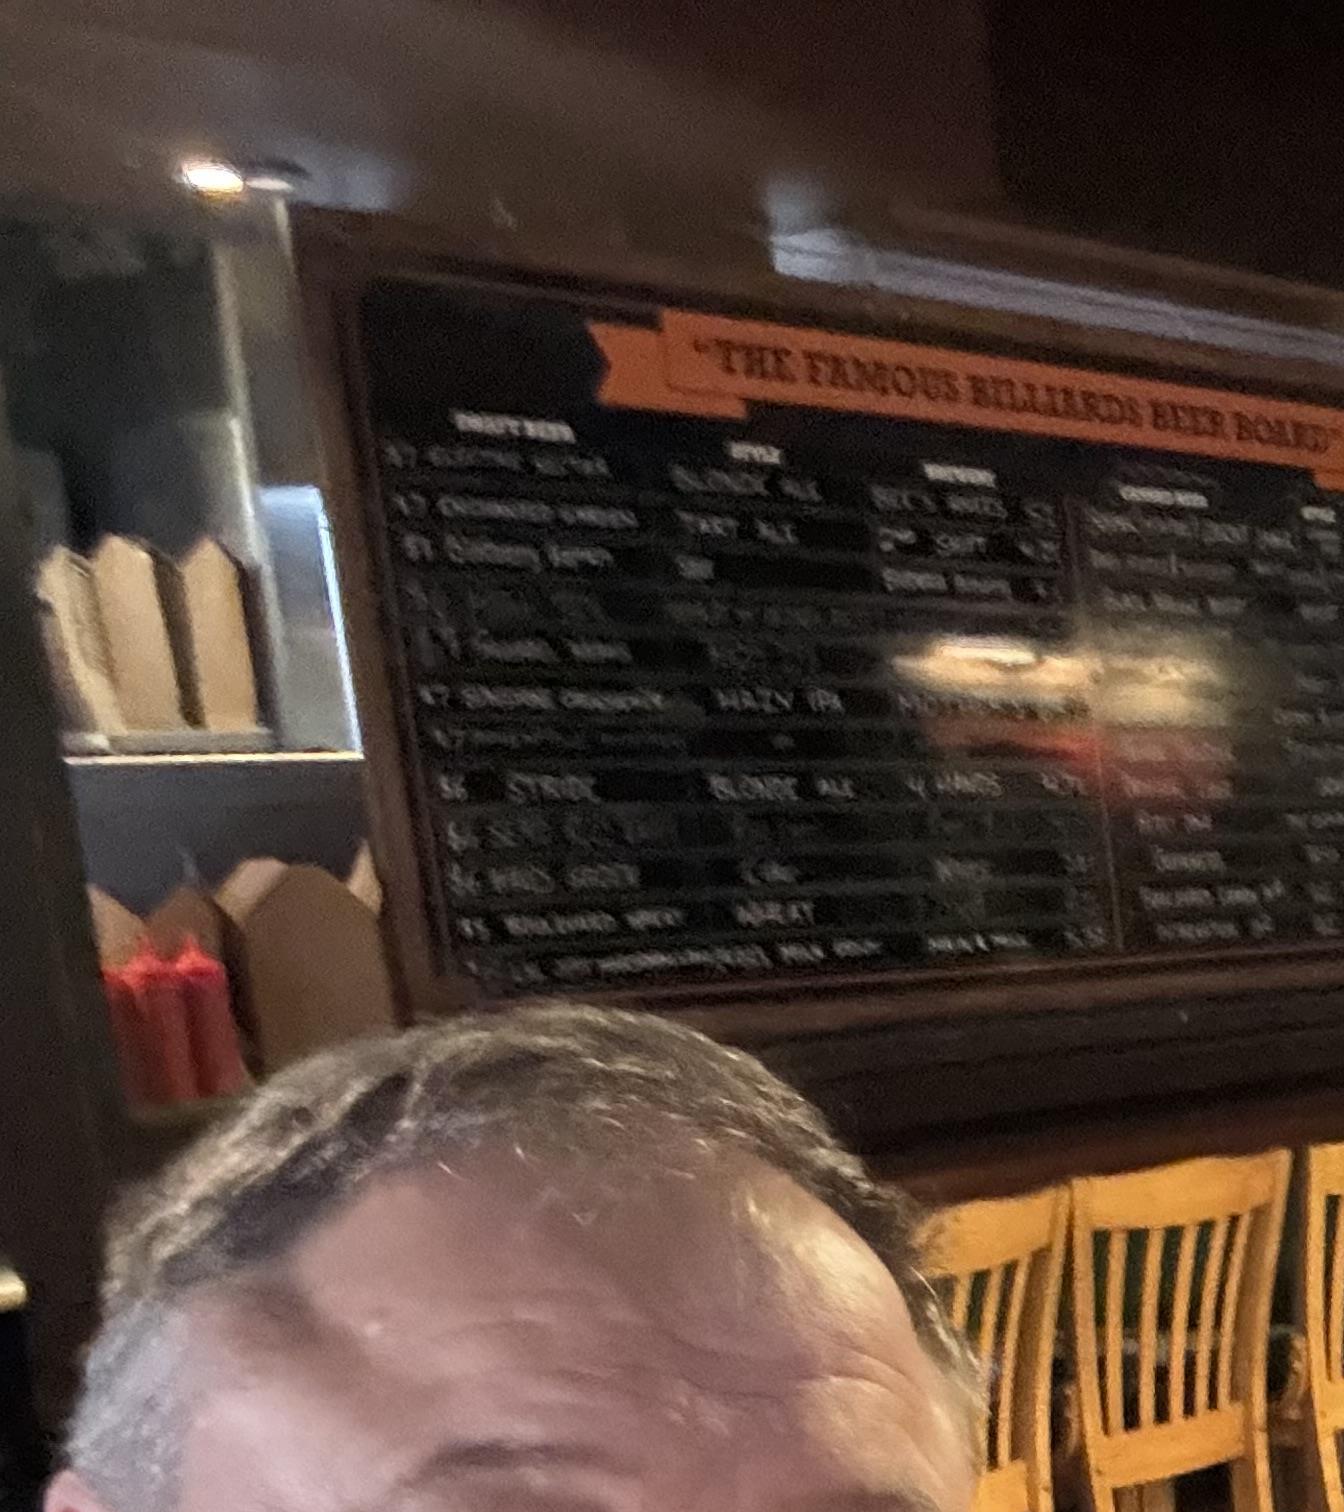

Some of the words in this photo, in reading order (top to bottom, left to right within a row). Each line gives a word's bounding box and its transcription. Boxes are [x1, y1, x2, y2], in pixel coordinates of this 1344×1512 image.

[803, 351, 959, 403] FAMOUS
[965, 374, 1143, 427] BILLIARDS
[1149, 400, 1230, 440] BEER
